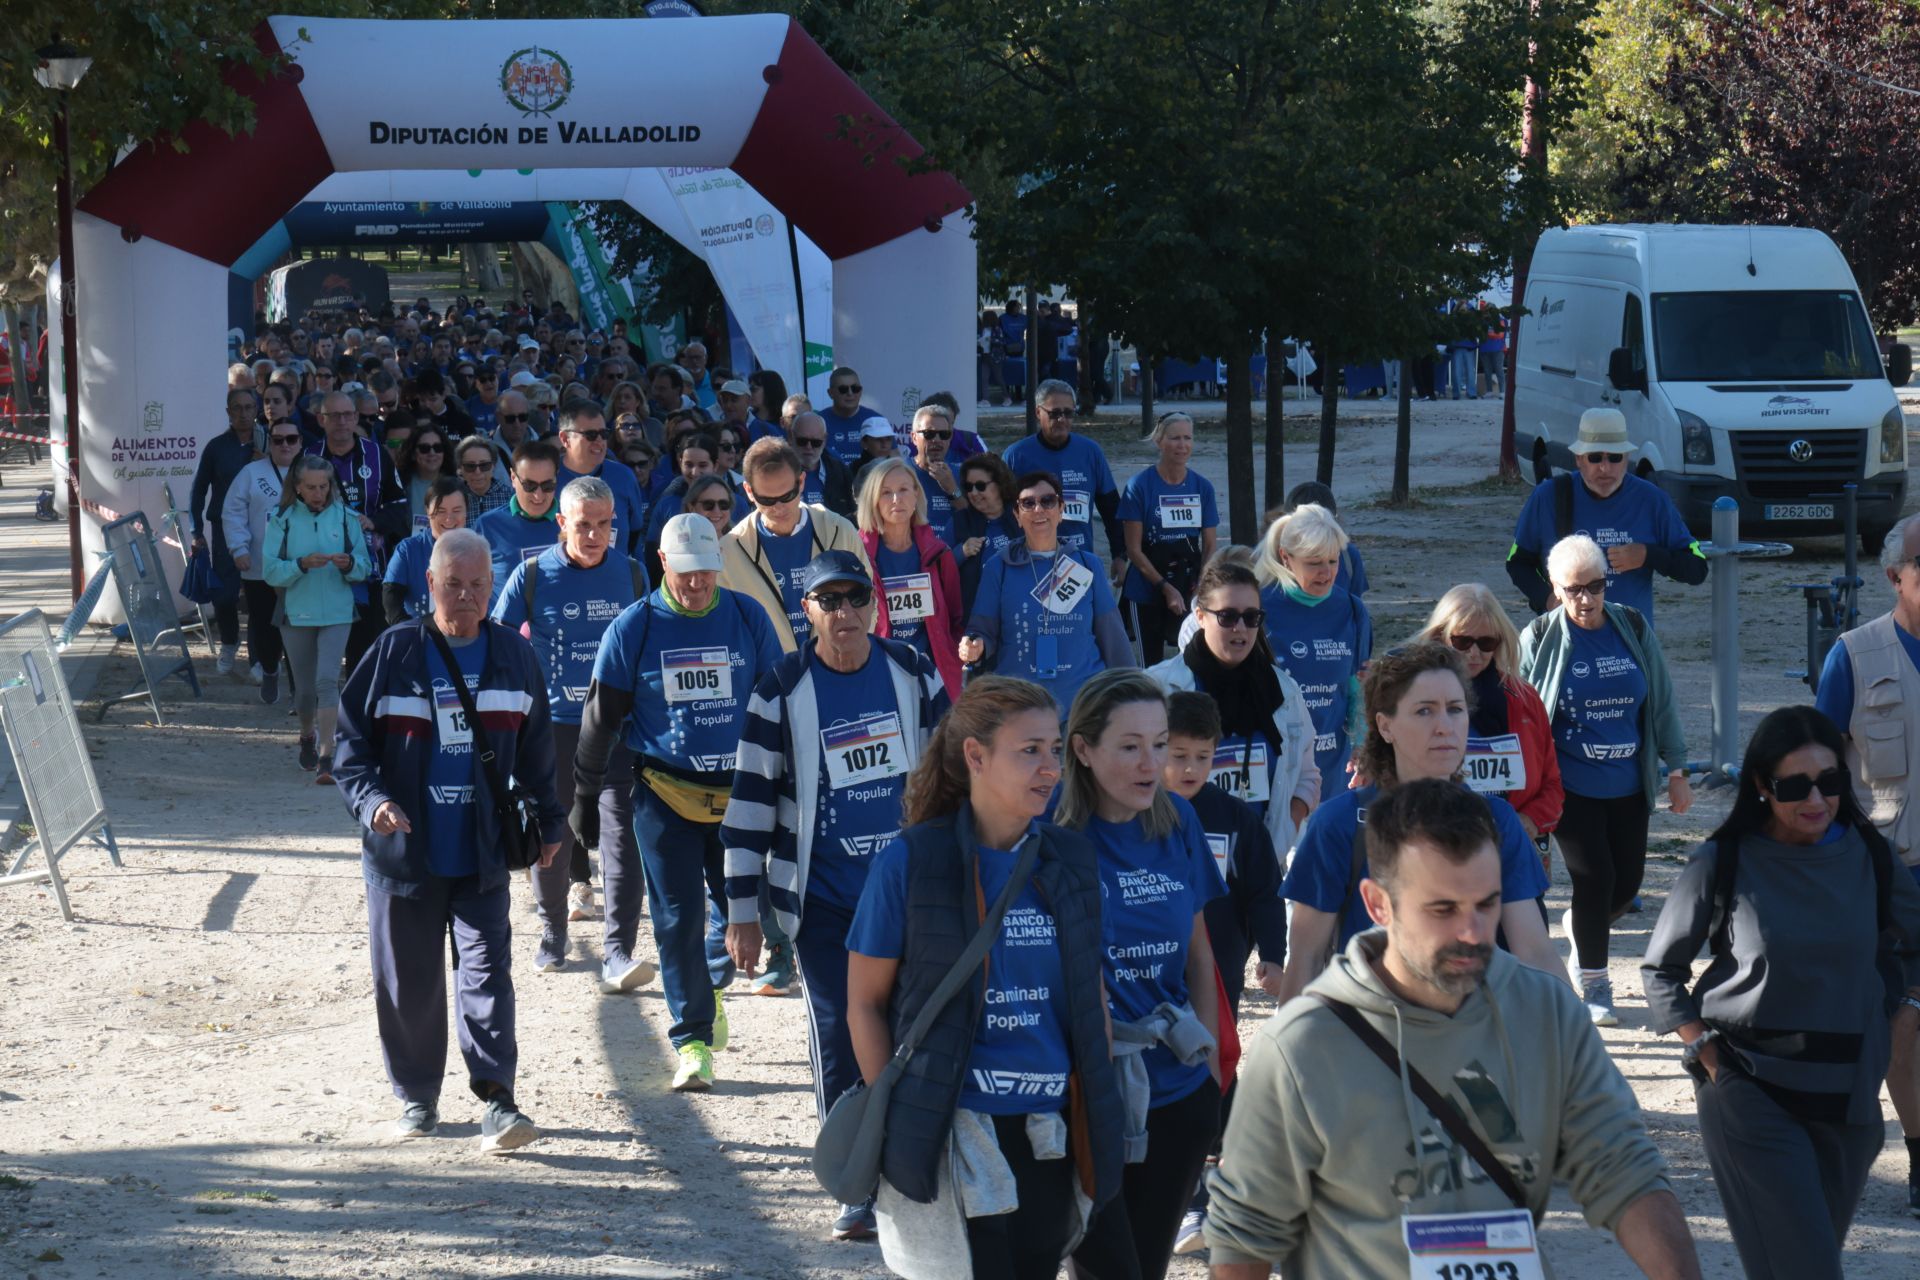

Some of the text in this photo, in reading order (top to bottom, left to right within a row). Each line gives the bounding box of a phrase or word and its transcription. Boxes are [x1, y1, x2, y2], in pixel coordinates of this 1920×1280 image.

[323, 201, 405, 214] Ayuntamiento
[440, 201, 453, 210] de
[355, 224, 399, 236] FMD
[256, 477, 278, 498] KEEP
[1169, 509, 1193, 521] 1118
[1774, 506, 1831, 518] 2262 GDC
[791, 571, 805, 579] BAN
[1055, 577, 1081, 602] 451
[886, 592, 923, 611] 1248
[571, 640, 600, 648] Camin
[571, 651, 597, 663] Popul
[1315, 648, 1352, 656] ALIMENTOS
[1596, 659, 1620, 668] BANCO
[1599, 663, 1637, 674] ALIMENTOS
[674, 669, 719, 690] 1005
[691, 698, 738, 711] Caminata
[1305, 697, 1333, 709] opular
[1585, 696, 1634, 707] Caminata
[450, 712, 471, 732] 13
[694, 713, 733, 727] Popular
[1586, 709, 1625, 722] Popular
[440, 742, 474, 756] Popul
[841, 742, 891, 773] 1072
[1468, 758, 1511, 780] 1074
[1214, 770, 1250, 791] 107
[847, 786, 893, 803] Popular
[1118, 873, 1157, 888] BANCO
[1123, 881, 1185, 899] ALIMENTOS
[1003, 915, 1054, 927] BANCO D
[1006, 926, 1057, 938] ALIMENT
[1108, 940, 1179, 960] Caminata
[985, 986, 1049, 1005] Caminata
[987, 1011, 1041, 1031] Popular
